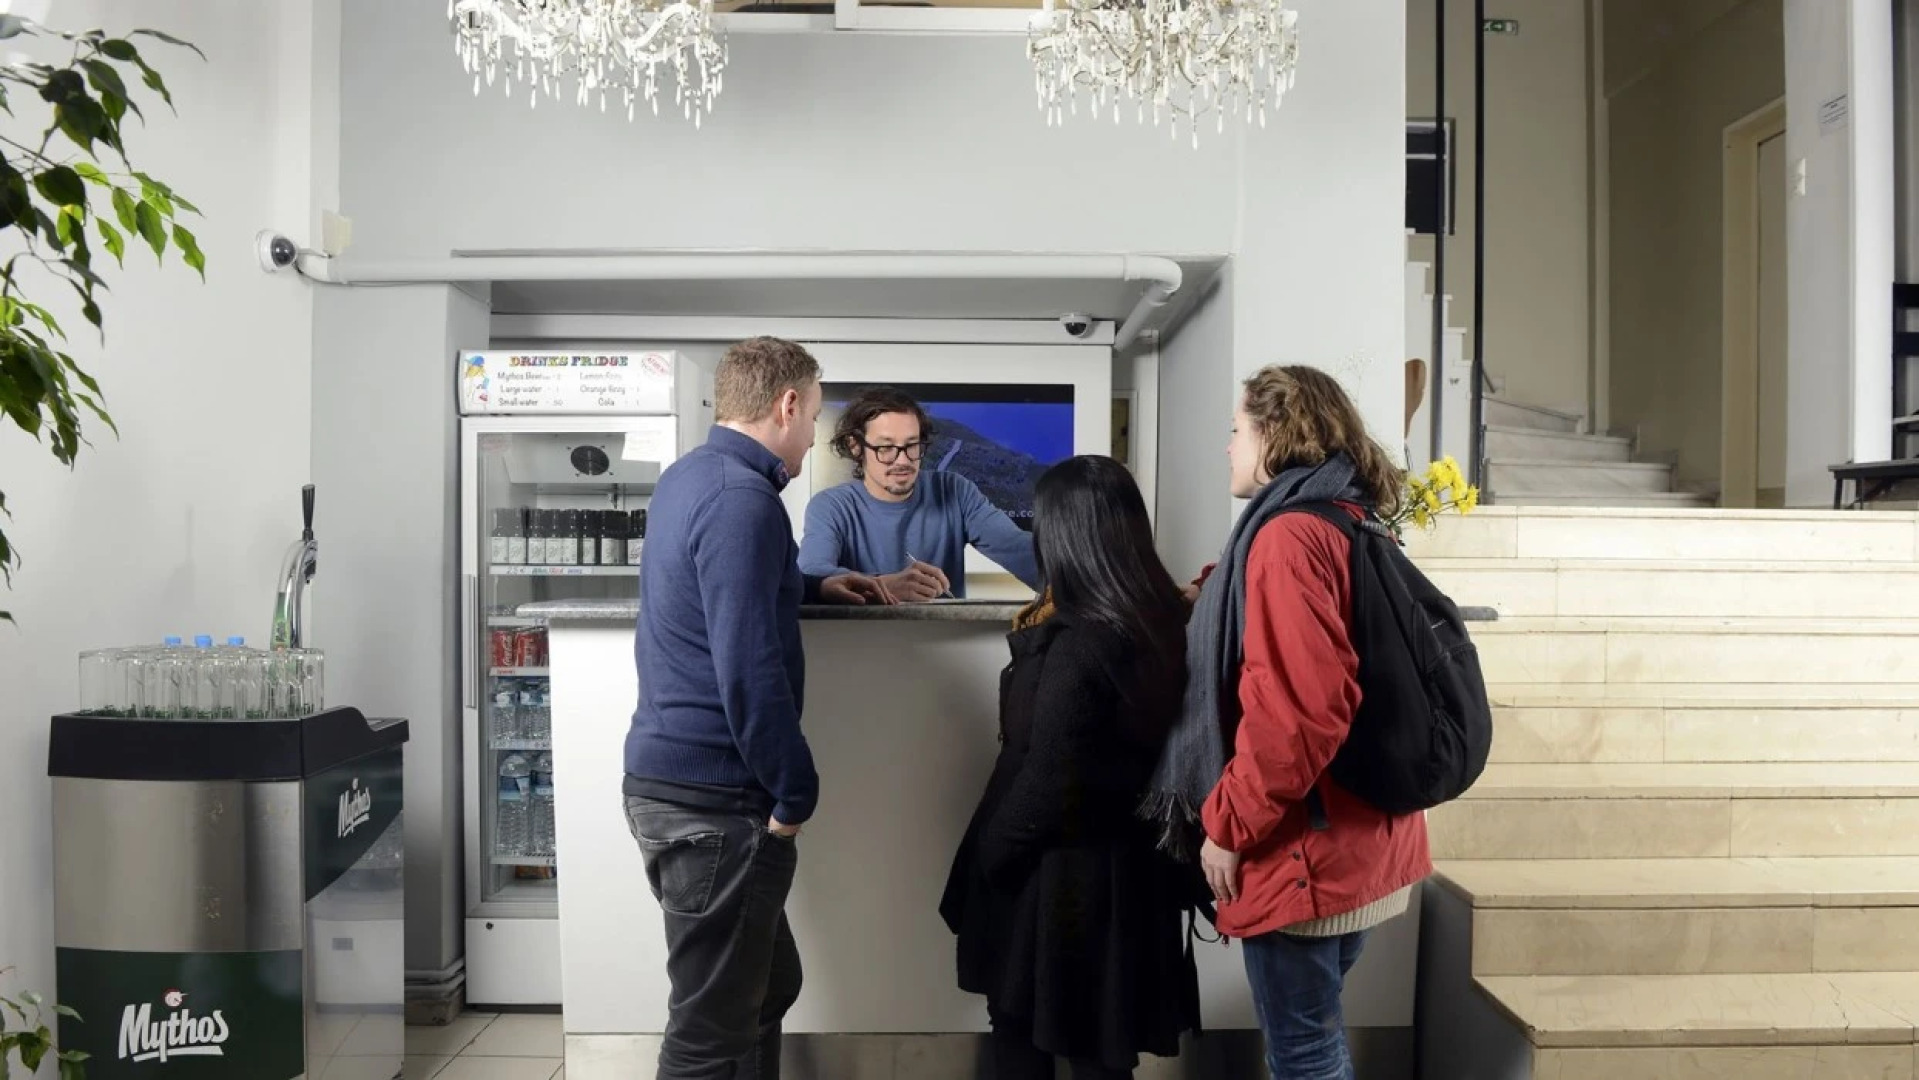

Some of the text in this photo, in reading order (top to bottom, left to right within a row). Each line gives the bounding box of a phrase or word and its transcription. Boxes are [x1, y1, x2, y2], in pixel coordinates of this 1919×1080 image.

[509, 356, 568, 367] DRINKS
[571, 356, 628, 367] FRIDGE
[497, 372, 524, 383] Mythos
[500, 385, 520, 395] Large
[580, 385, 606, 395] Orange
[498, 398, 517, 407] Small
[598, 398, 615, 406] Cola
[338, 787, 371, 839] Mythos
[118, 1003, 230, 1063] Mythos
